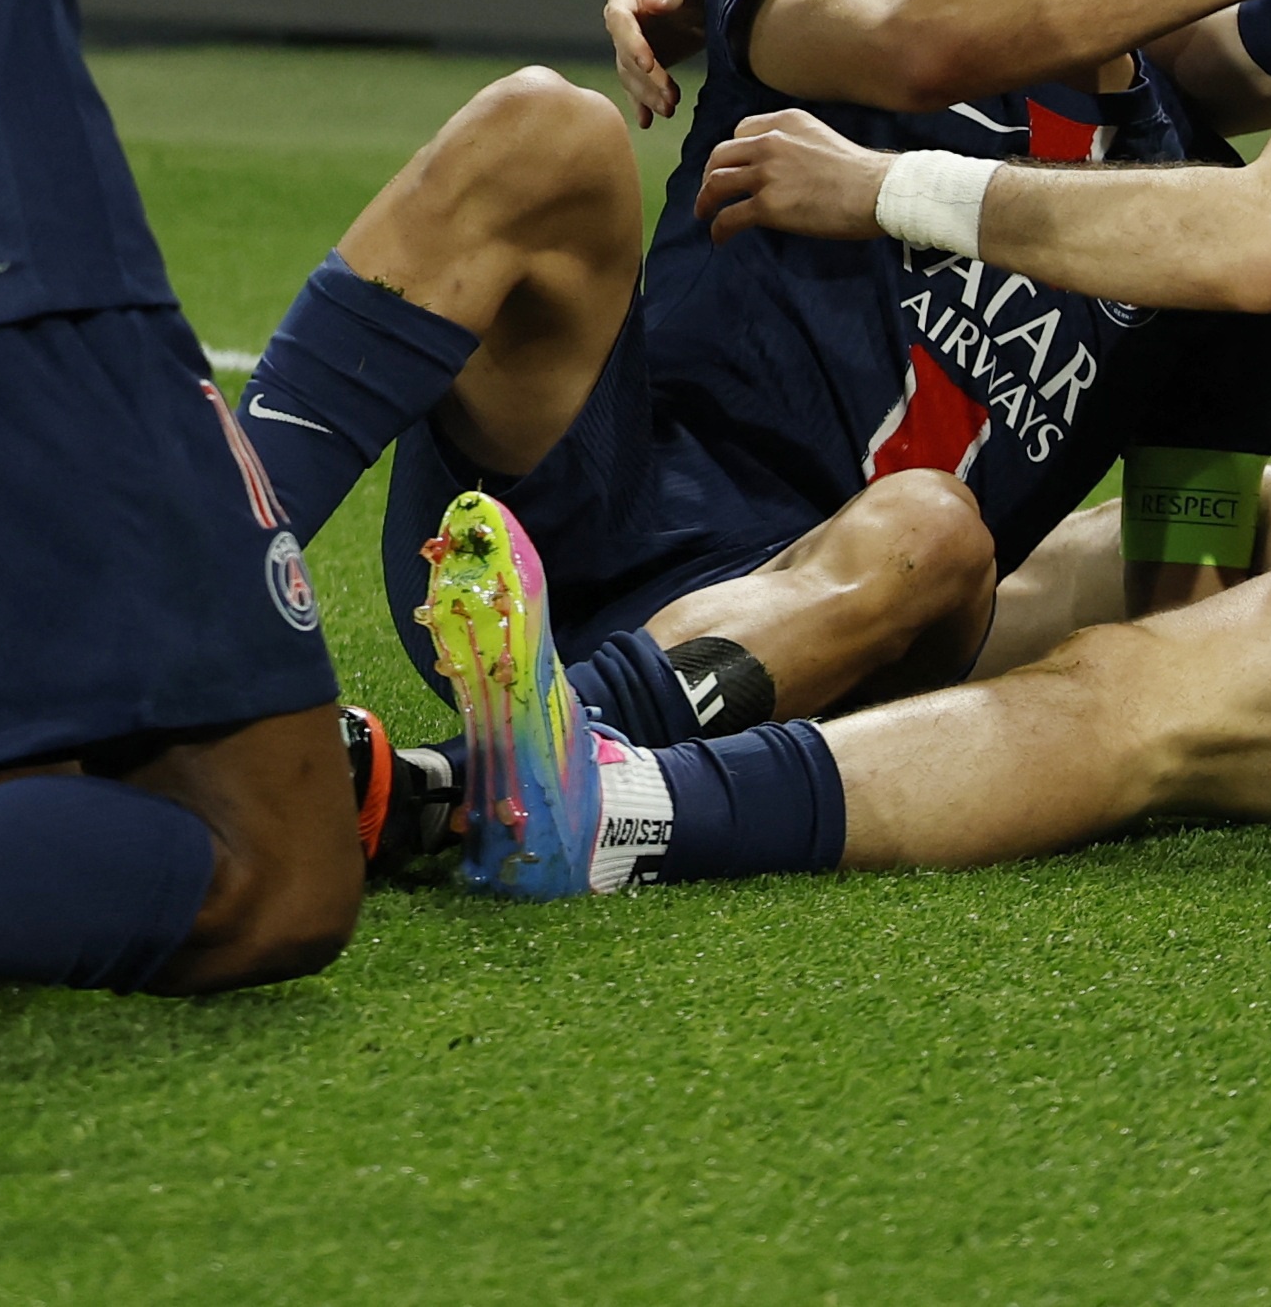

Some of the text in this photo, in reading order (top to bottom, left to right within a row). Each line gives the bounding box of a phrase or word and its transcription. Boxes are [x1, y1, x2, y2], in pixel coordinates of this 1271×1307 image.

[900, 289, 1064, 464] AIRWAYS
[903, 240, 1097, 426] ATAR
[1140, 494, 1239, 521] RESPECT
